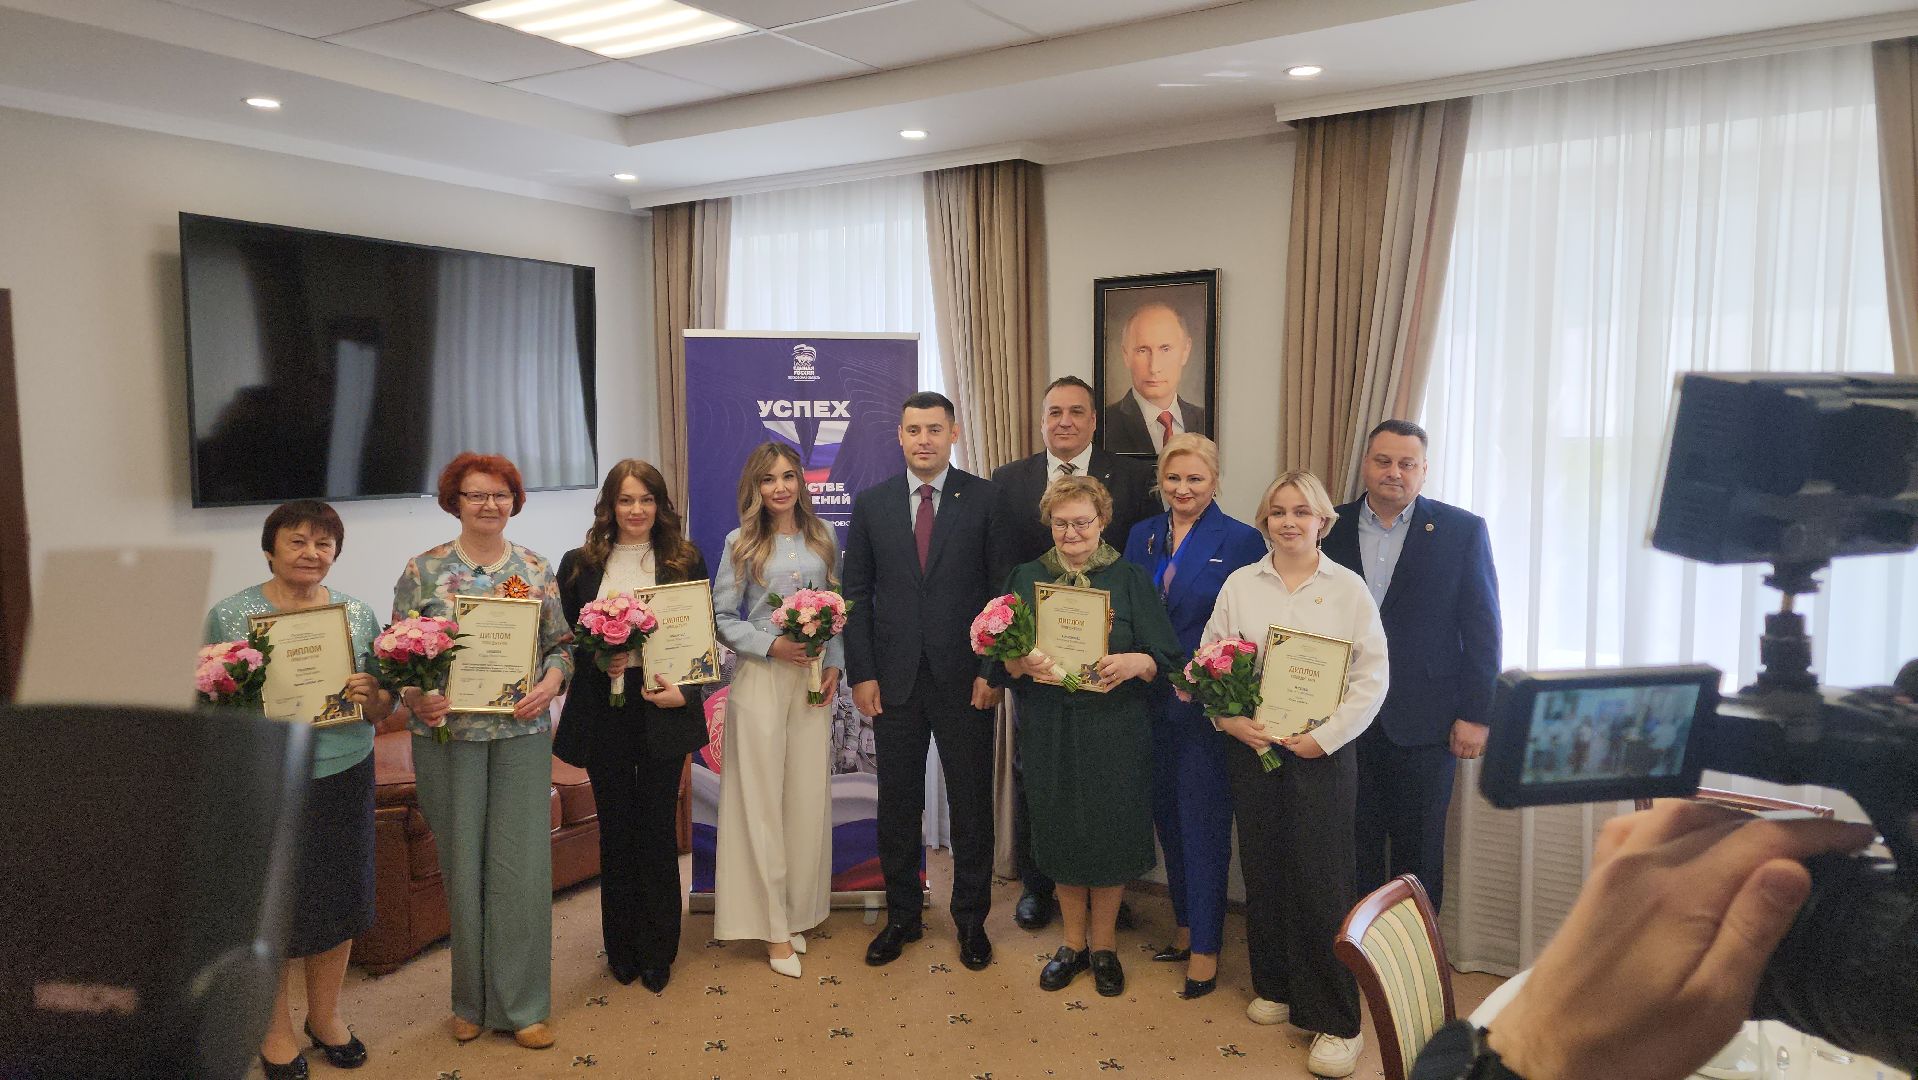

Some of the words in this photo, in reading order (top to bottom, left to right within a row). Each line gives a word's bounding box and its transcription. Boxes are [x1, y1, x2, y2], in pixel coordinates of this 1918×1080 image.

[757, 400, 851, 417] УСПЕХ
[805, 483, 844, 492] СТВЕ
[812, 493, 851, 504] ЕНИЙ
[286, 644, 322, 658] ДИПЛОМ
[1288, 665, 1320, 678] ДИПЛОМ
